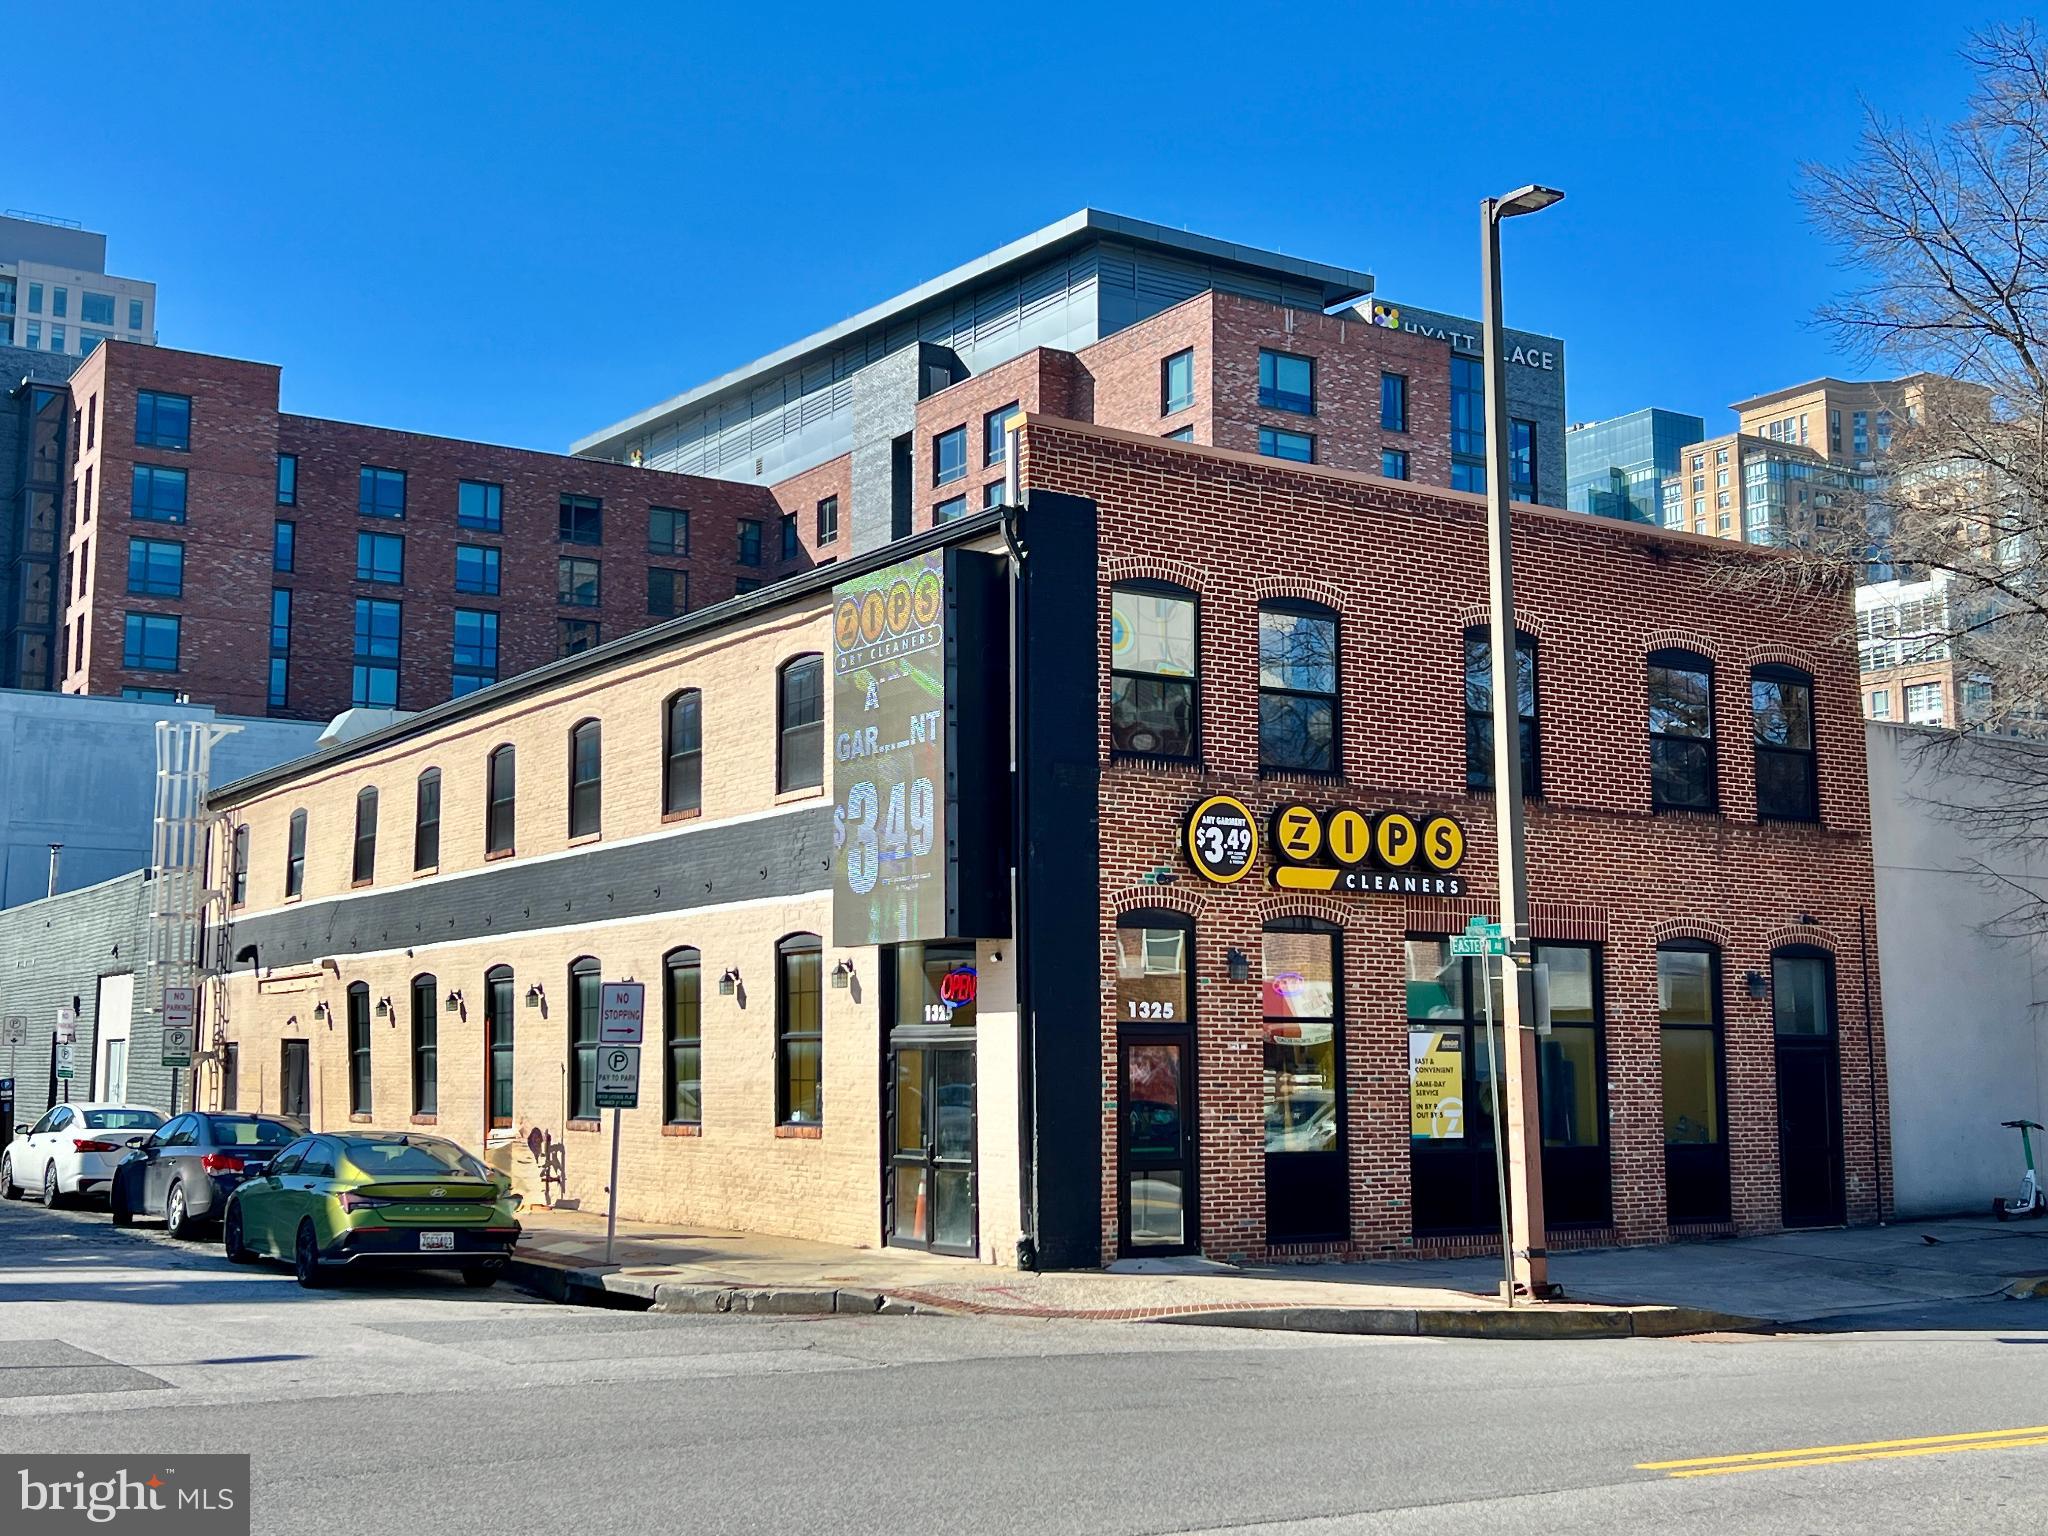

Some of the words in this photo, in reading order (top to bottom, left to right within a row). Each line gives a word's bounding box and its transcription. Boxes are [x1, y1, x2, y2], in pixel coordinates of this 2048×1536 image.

[1503, 346, 1553, 371] ACE
[838, 576, 938, 646] ZIPS
[841, 651, 863, 668] DRY
[870, 630, 933, 659] CLEANERS
[1202, 816, 1215, 825] ANY
[1196, 826, 1251, 864] $3.49
[1286, 814, 1453, 861] ZIPS
[1346, 873, 1459, 895] CLEANERS
[941, 973, 976, 1000] OPEN
[173, 992, 185, 1001] NO
[616, 993, 629, 1004] NO
[604, 1009, 640, 1020] STOPPING
[925, 1004, 953, 1022] 1325
[1128, 1001, 1174, 1019] 1325
[1415, 1066, 1454, 1074] CONVENIENT
[1415, 1080, 1446, 1088] SAME-DAY
[1416, 1089, 1439, 1097] SERVICE
[1416, 1111, 1429, 1119] OUT
